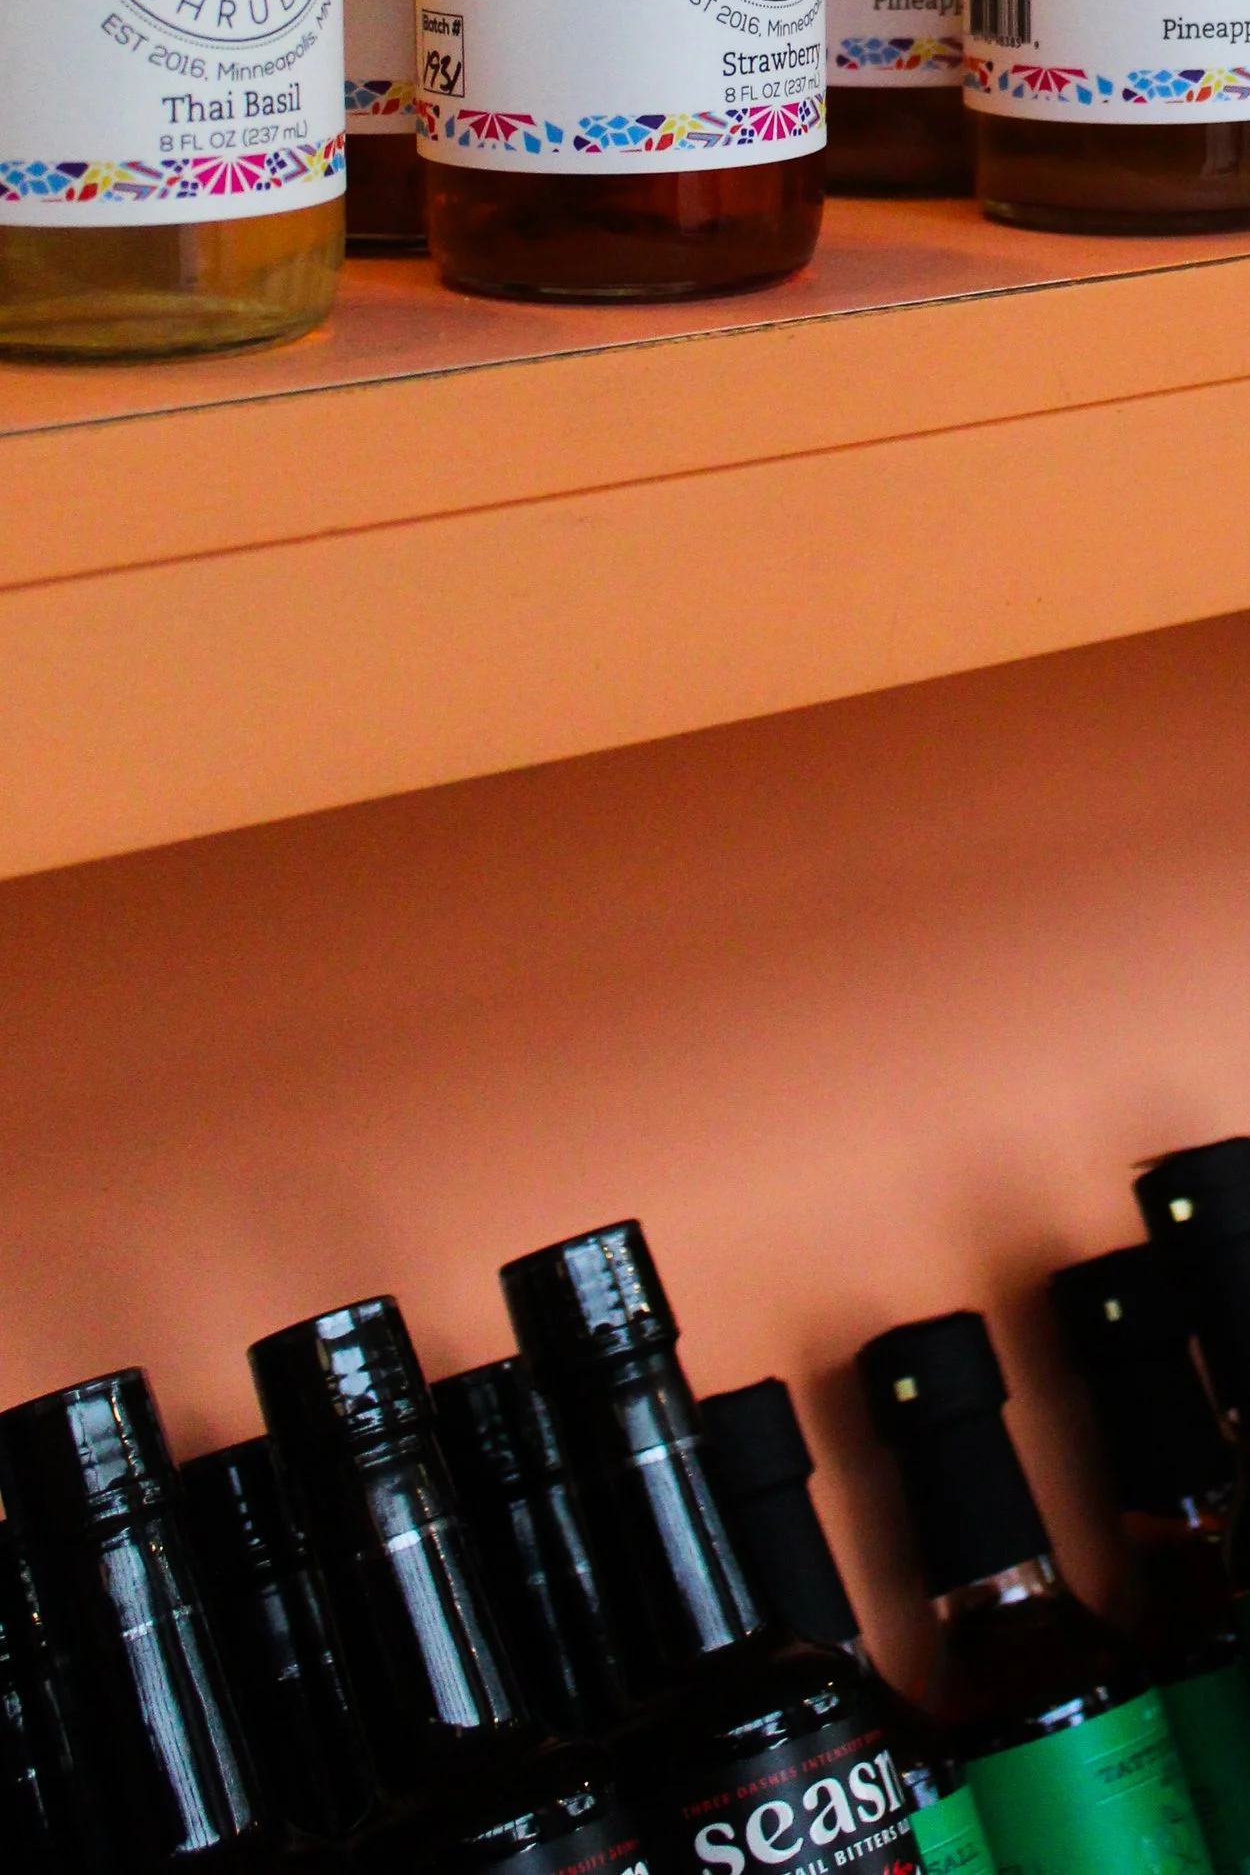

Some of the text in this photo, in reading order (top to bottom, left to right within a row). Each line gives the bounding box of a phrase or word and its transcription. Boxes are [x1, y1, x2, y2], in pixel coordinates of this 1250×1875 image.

[101, 12, 148, 53] EST
[422, 14, 450, 35] Batch
[723, 42, 820, 76] Strawberry
[162, 82, 302, 126] Thai Basil
[725, 87, 736, 103] 8
[741, 86, 758, 101] FL
[762, 82, 780, 99] OZ
[784, 76, 806, 97] (237
[159, 135, 173, 152] 8
[180, 133, 203, 152] FL
[209, 129, 236, 150] OZ
[242, 123, 279, 147] (237
[683, 1792, 731, 1819] THREE
[736, 1765, 798, 1800] DASHES
[694, 1749, 906, 1875] seasn
[834, 1825, 897, 1867] BITTERS
